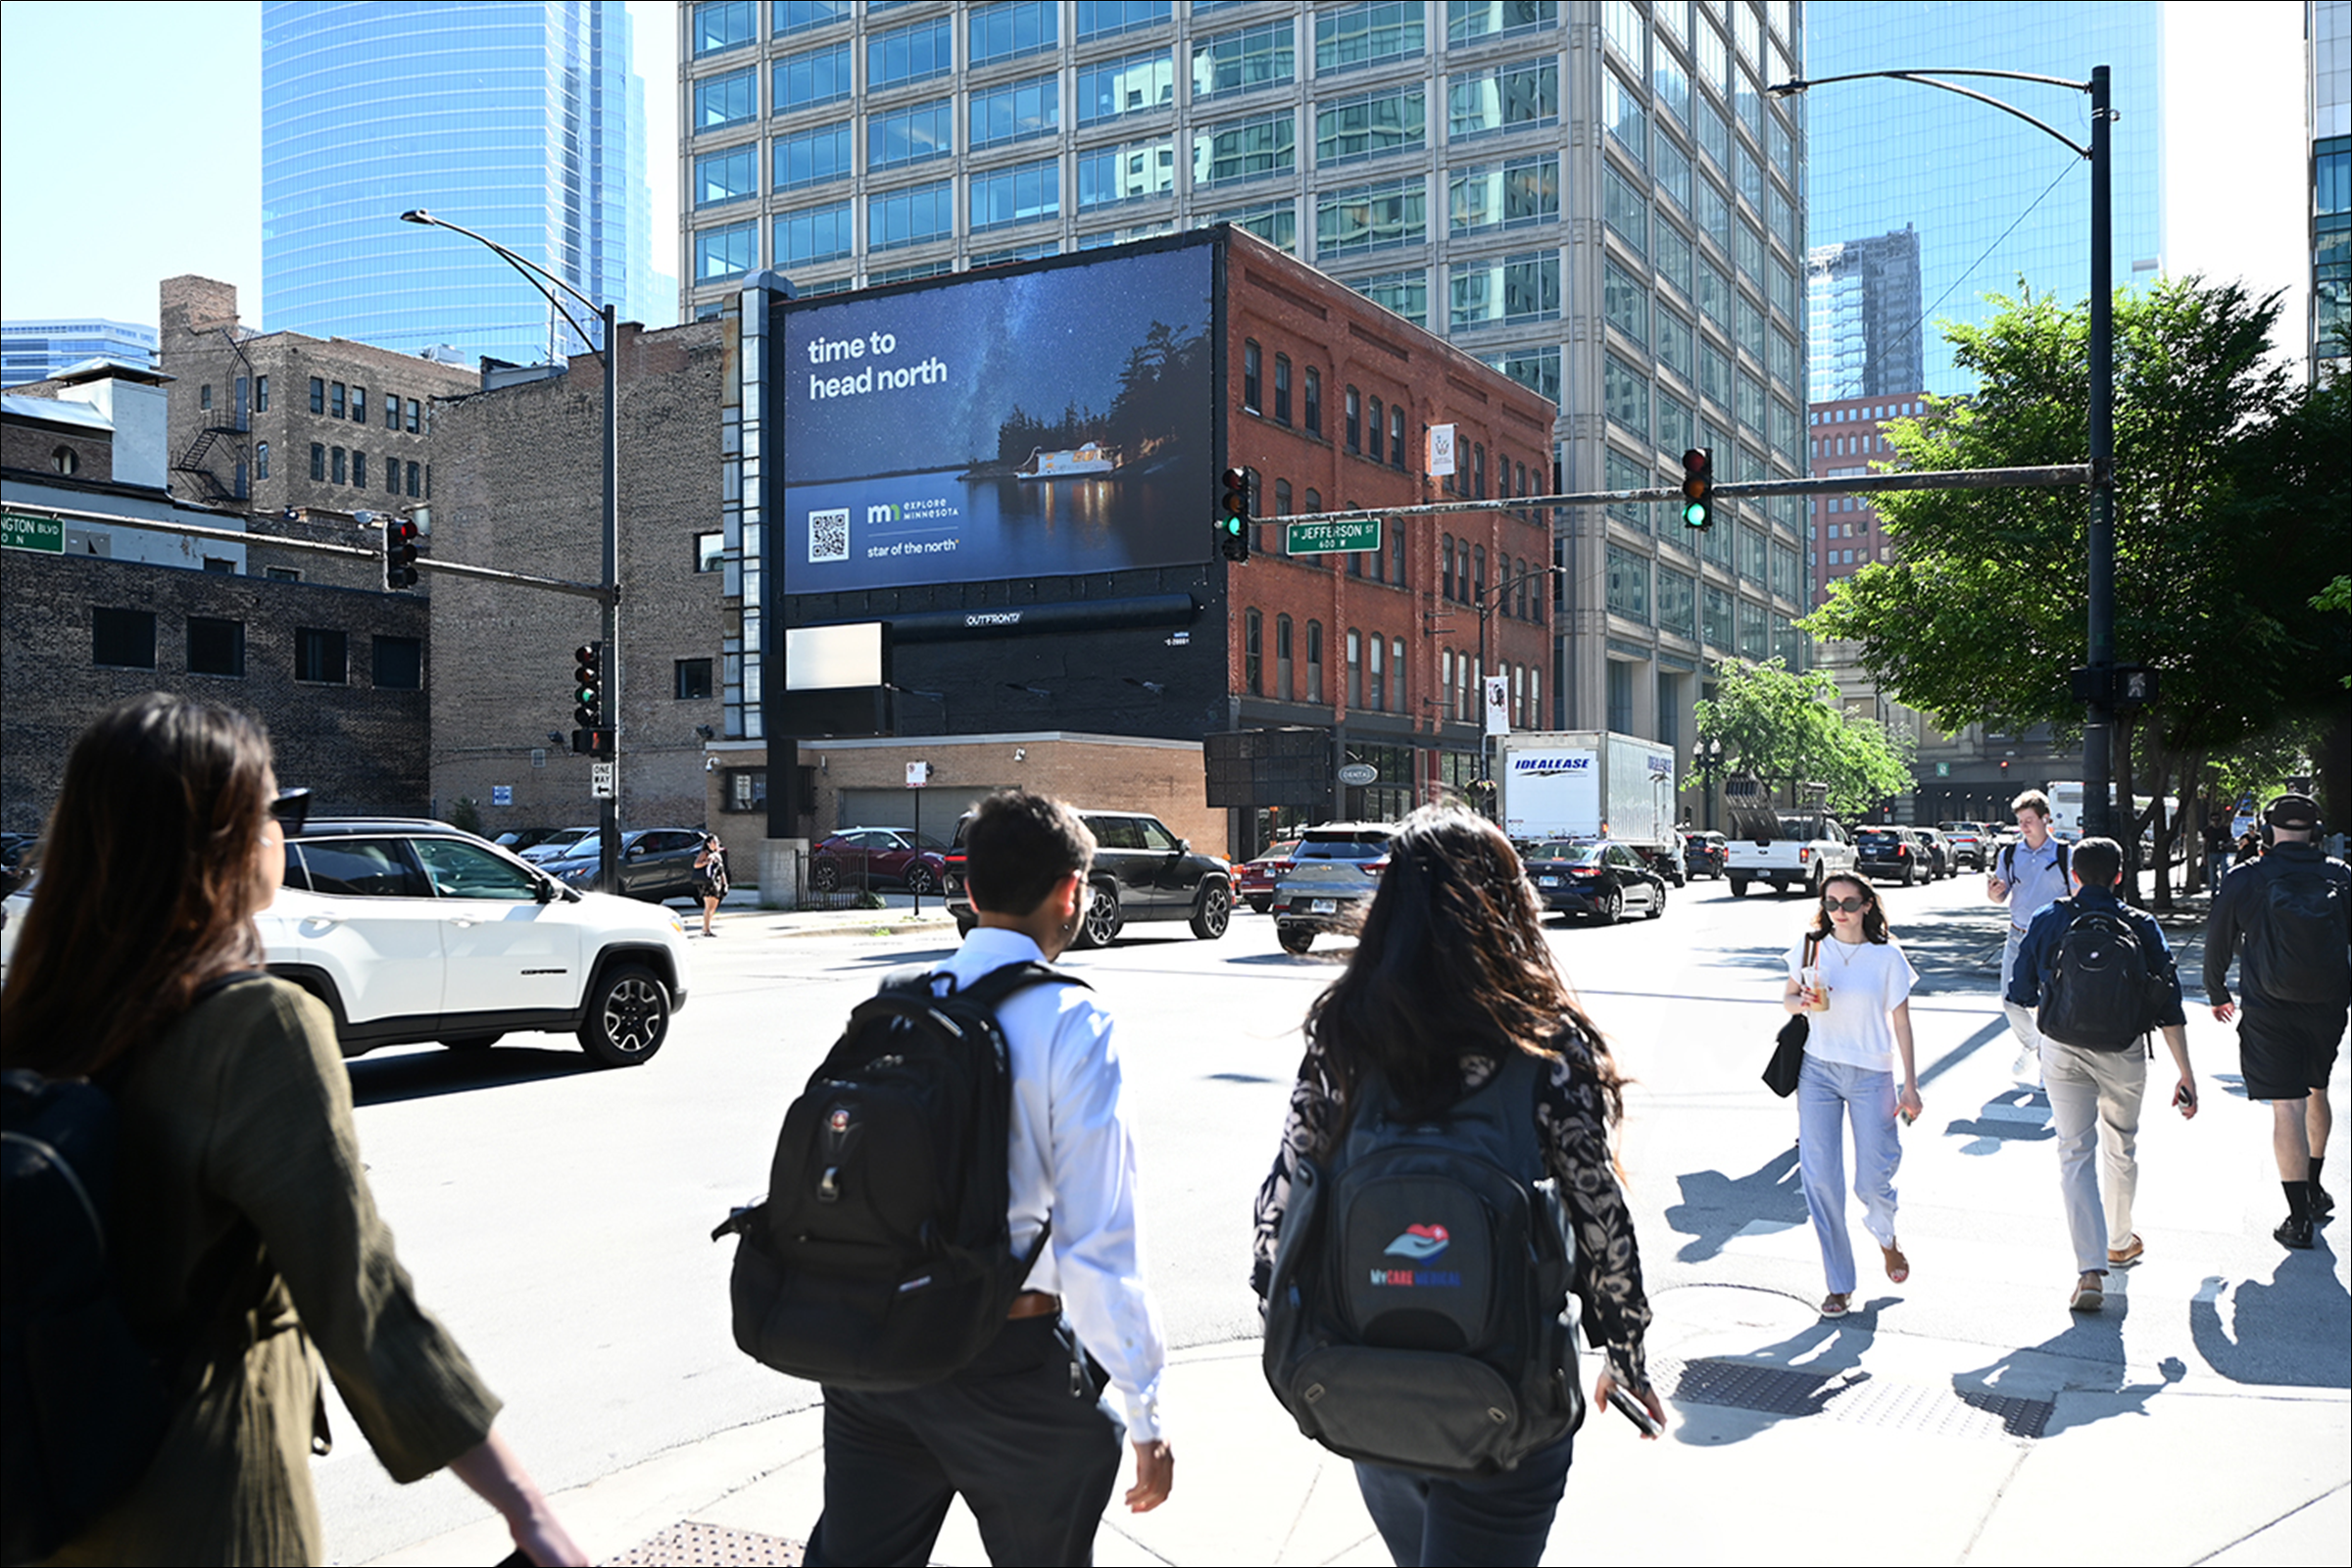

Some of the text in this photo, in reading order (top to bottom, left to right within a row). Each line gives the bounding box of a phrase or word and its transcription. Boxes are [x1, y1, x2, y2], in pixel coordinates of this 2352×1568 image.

[808, 331, 896, 364] time to
[809, 357, 948, 400] head north
[37, 523, 60, 536] BLVD
[1301, 524, 1362, 540] JEFFERSON
[1365, 524, 1374, 534] ST
[16, 534, 24, 545] N
[1319, 539, 1335, 549] 600
[867, 538, 956, 559] star of the north
[594, 764, 611, 774] ONE
[1514, 758, 1591, 770] IDEALEASE
